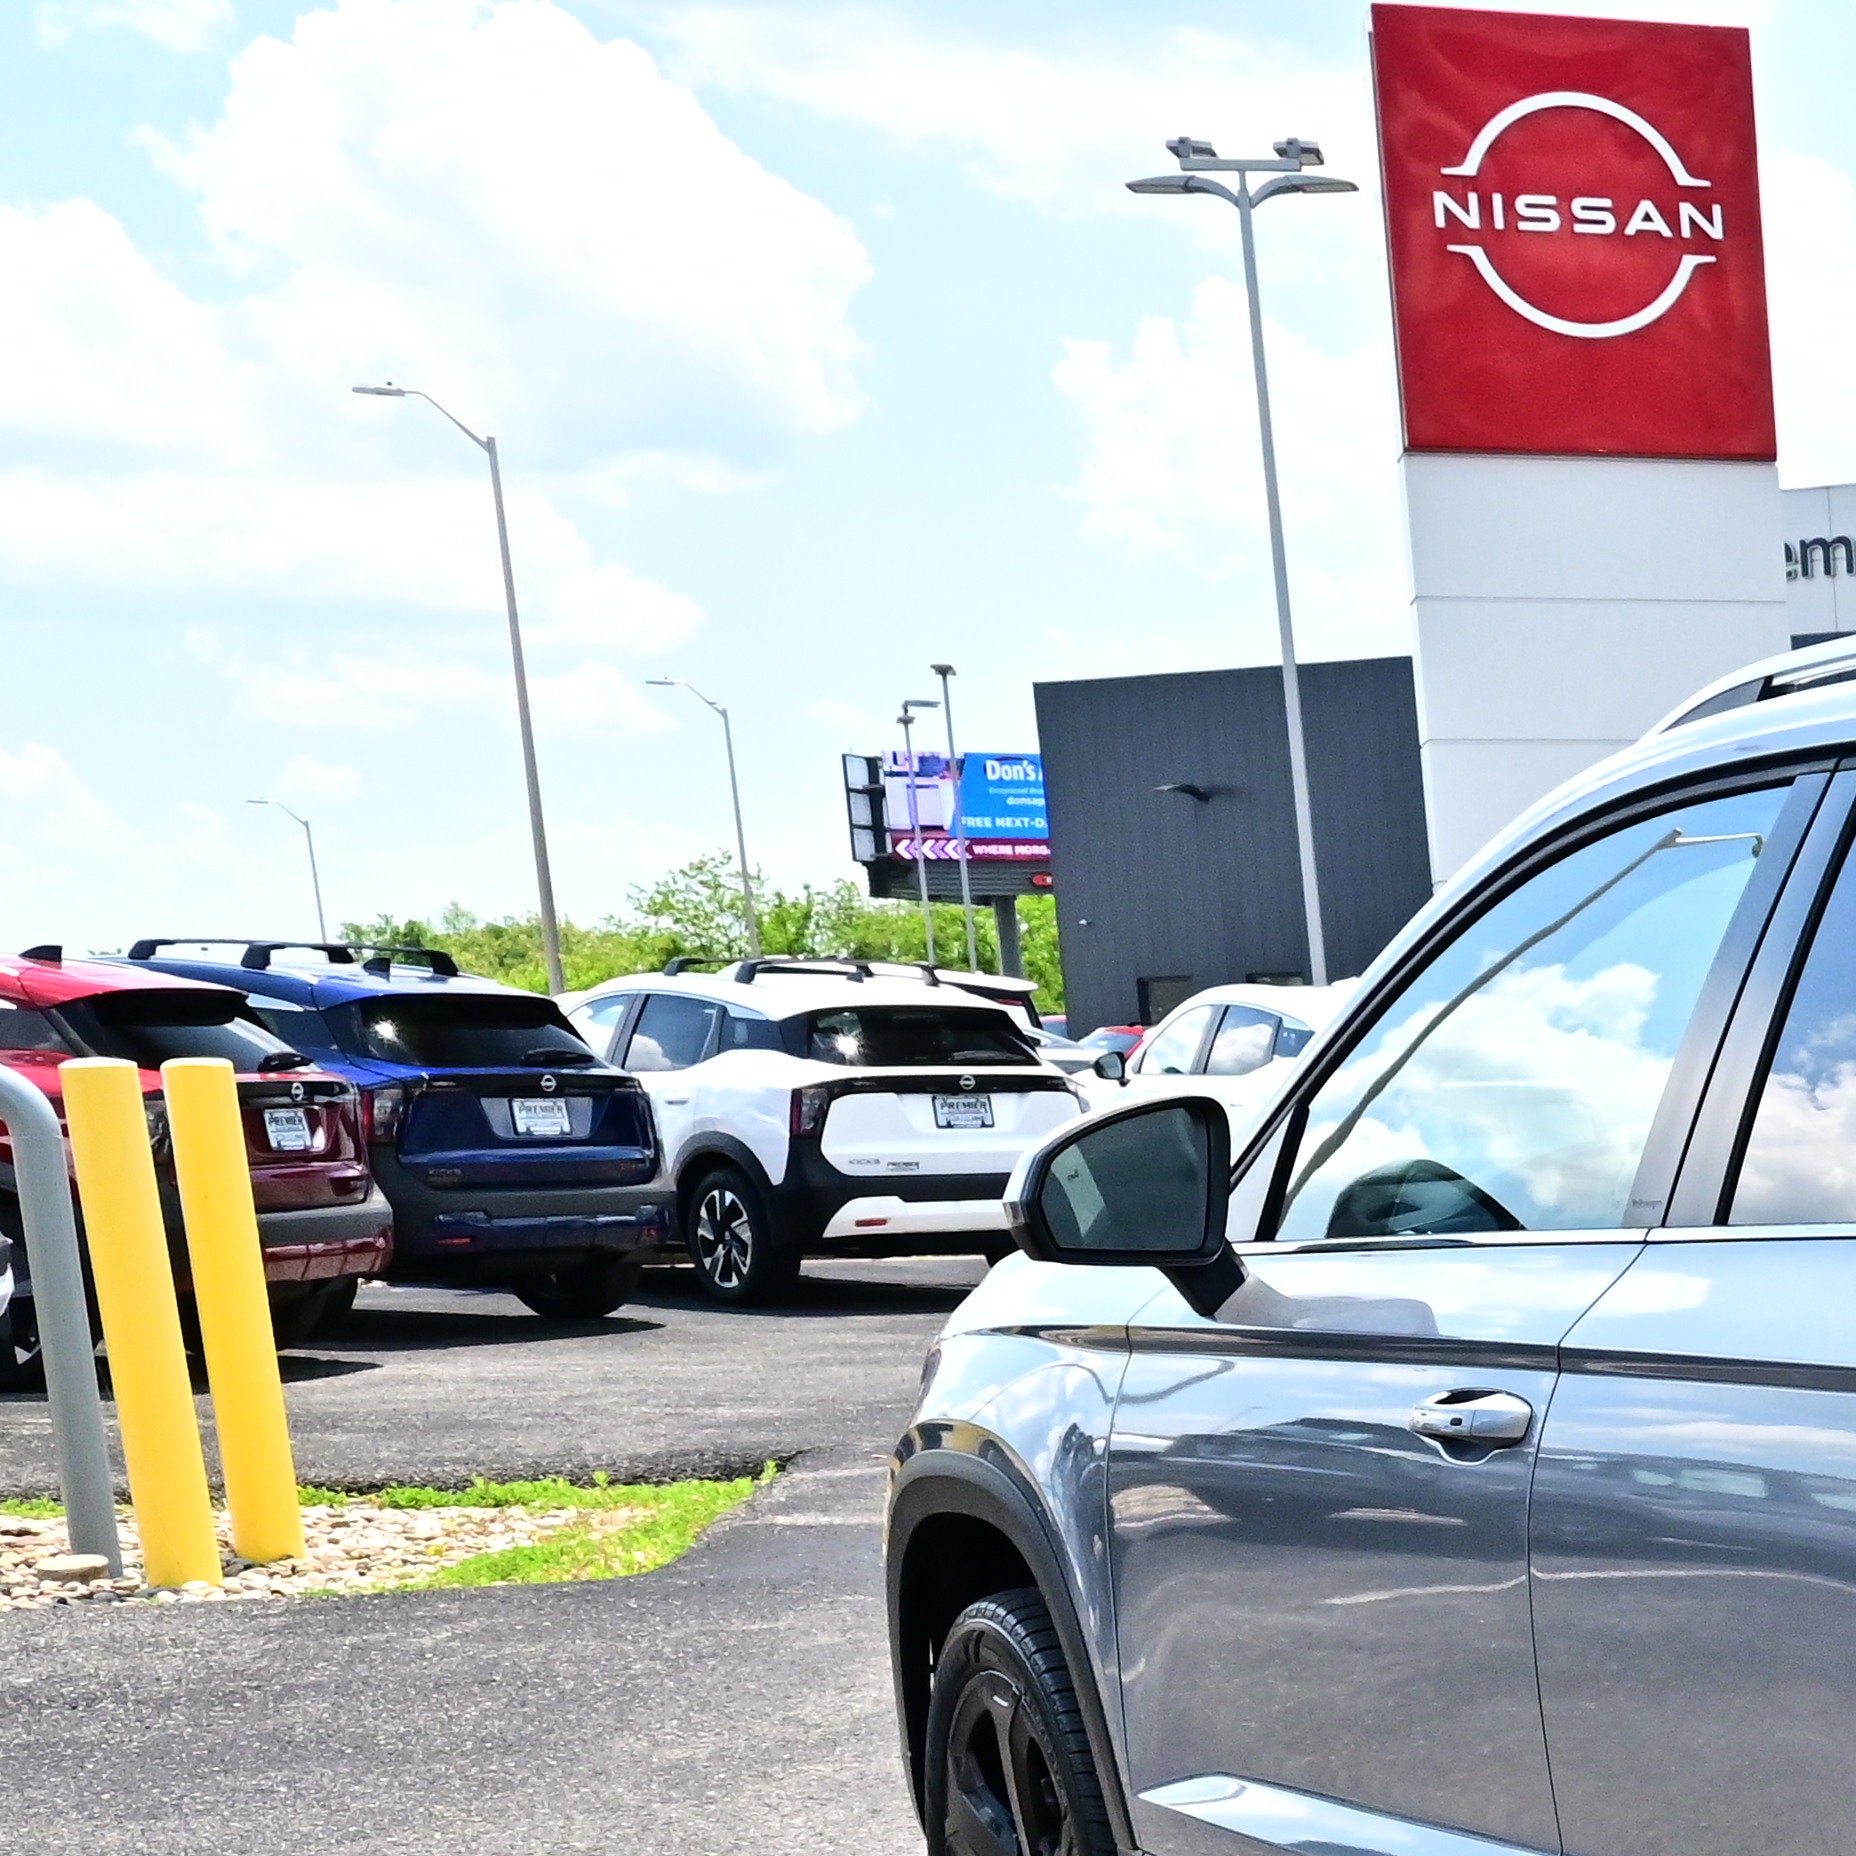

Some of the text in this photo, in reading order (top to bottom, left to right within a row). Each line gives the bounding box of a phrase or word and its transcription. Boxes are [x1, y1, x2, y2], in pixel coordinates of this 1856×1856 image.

[1432, 190, 1725, 241] NISSAN
[985, 759, 1036, 781] Don's
[995, 816, 1048, 828] NEXT-D
